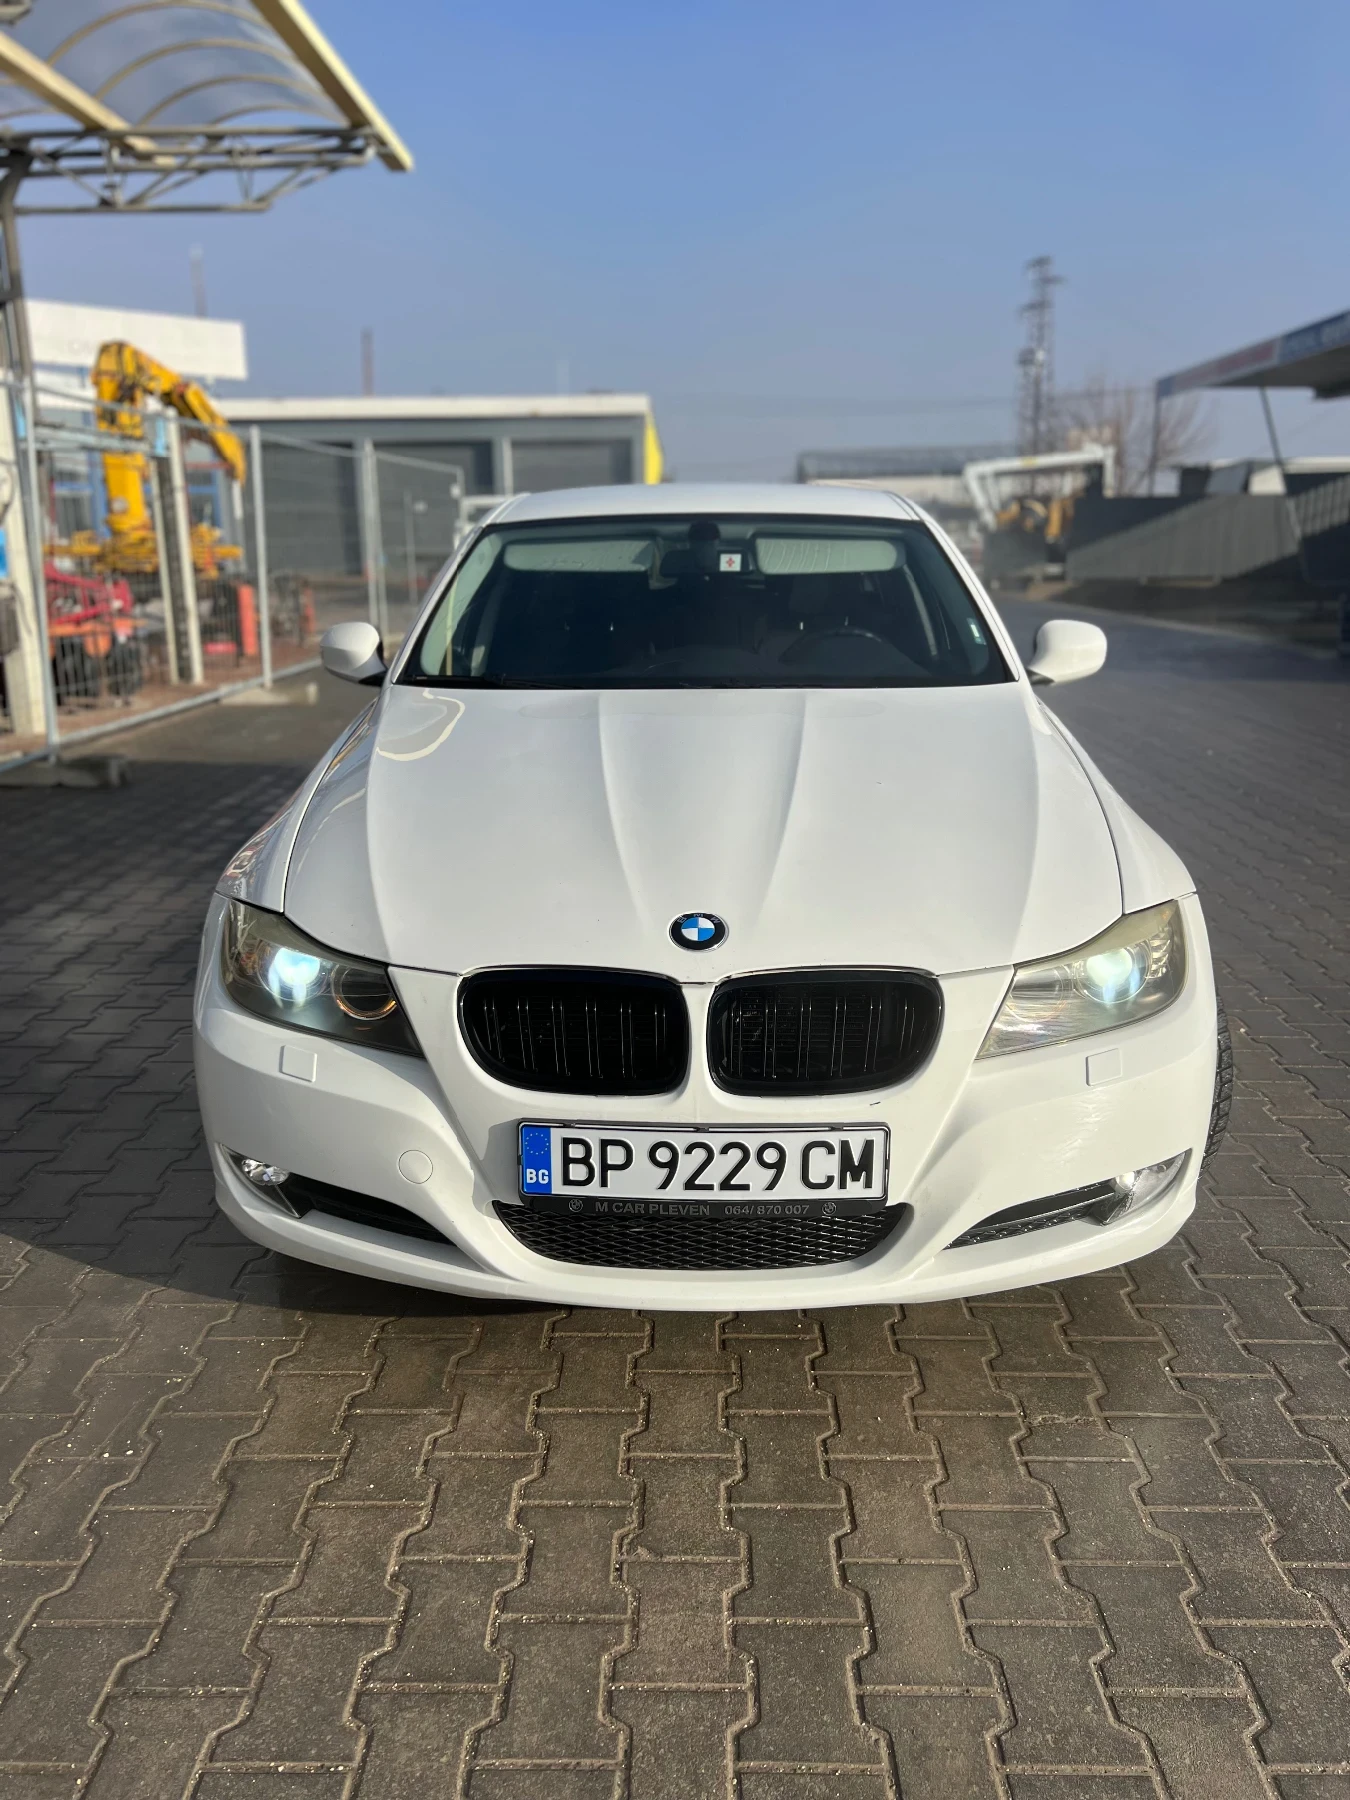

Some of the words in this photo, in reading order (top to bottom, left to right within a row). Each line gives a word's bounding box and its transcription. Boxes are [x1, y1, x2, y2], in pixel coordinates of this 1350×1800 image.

[562, 1137, 634, 1188] BP
[648, 1140, 787, 1191] 9229
[801, 1138, 875, 1190] CM
[526, 1168, 549, 1184] BG
[595, 1201, 609, 1213] M
[612, 1202, 645, 1214] CAR
[649, 1203, 710, 1216] PLEVEN
[724, 1205, 755, 1215] 064/
[757, 1205, 782, 1215] 870
[784, 1204, 810, 1215] 007
